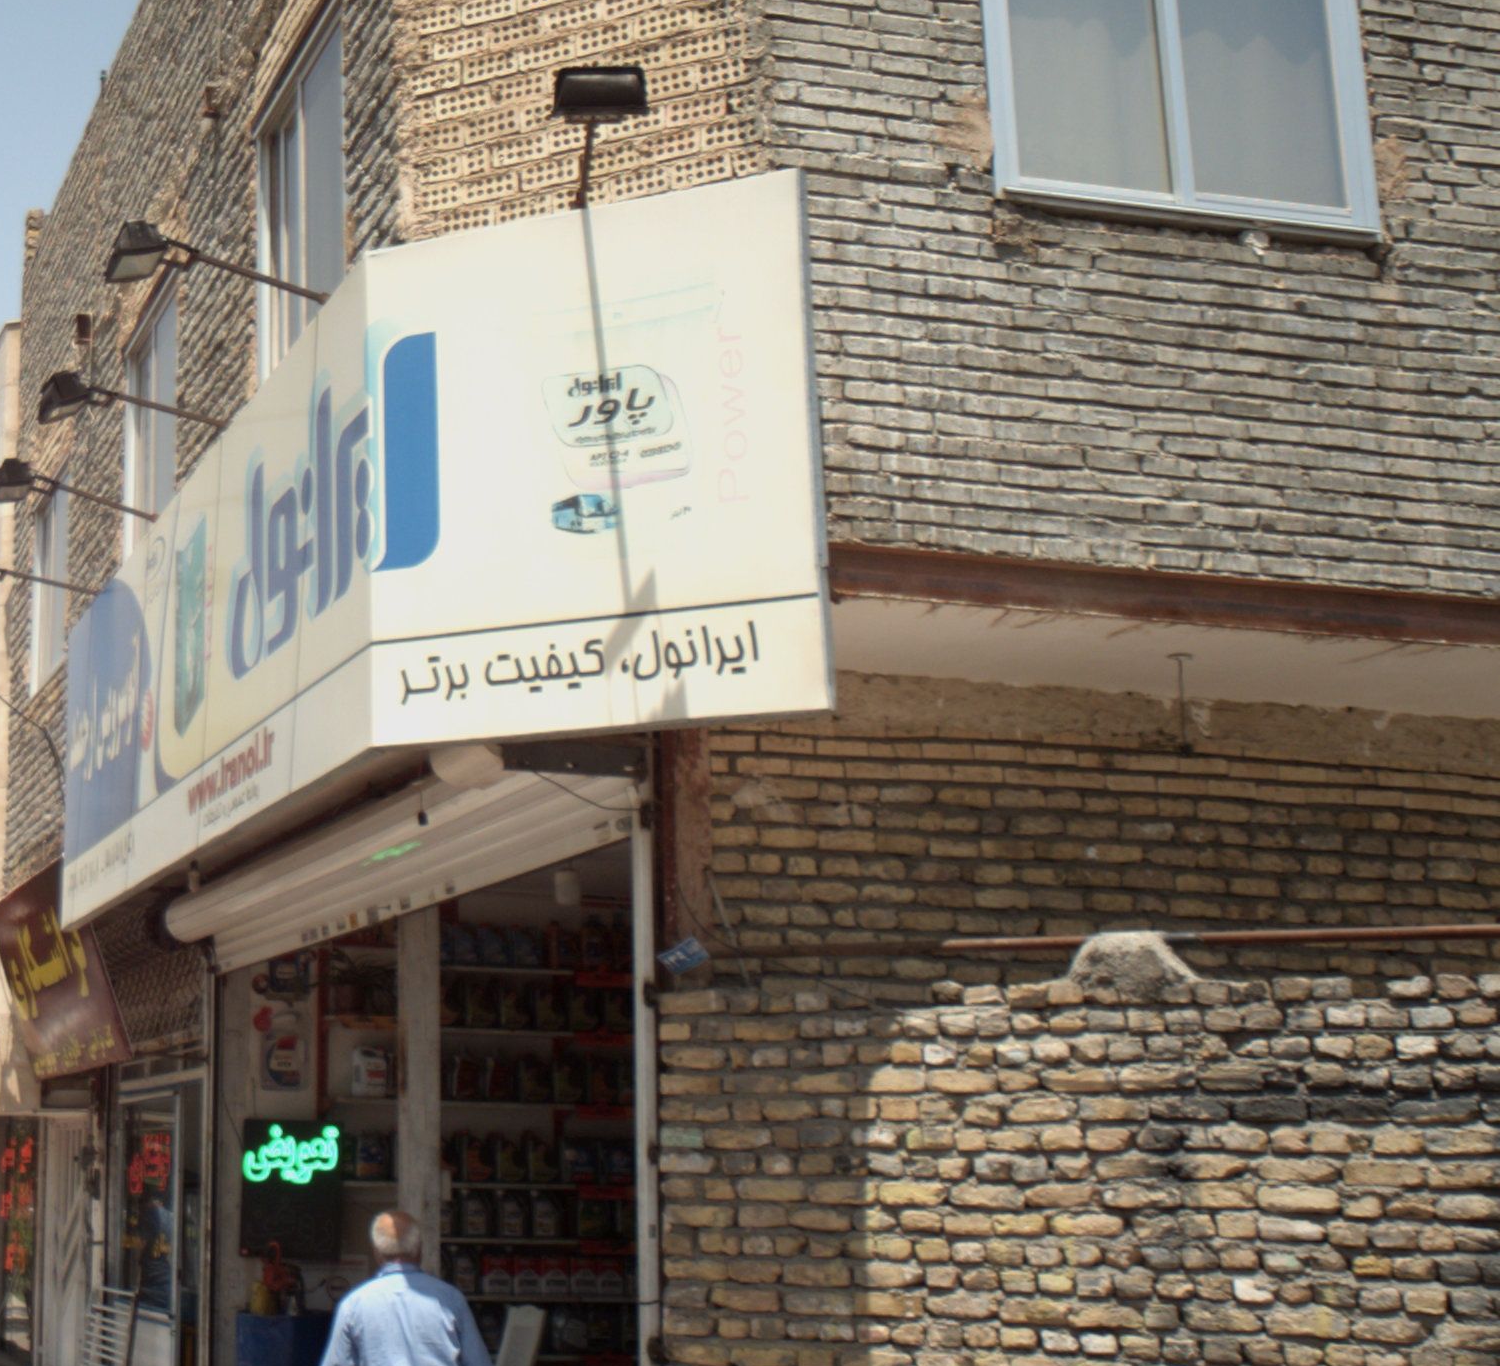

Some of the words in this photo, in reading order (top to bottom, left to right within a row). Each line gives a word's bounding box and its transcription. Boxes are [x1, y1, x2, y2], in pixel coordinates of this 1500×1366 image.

[567, 387, 655, 427] پاور
[231, 331, 441, 680] ایرانول
[400, 655, 470, 705] برتر
[484, 639, 606, 693] کیفیت
[242, 1123, 340, 1185] تعویض
